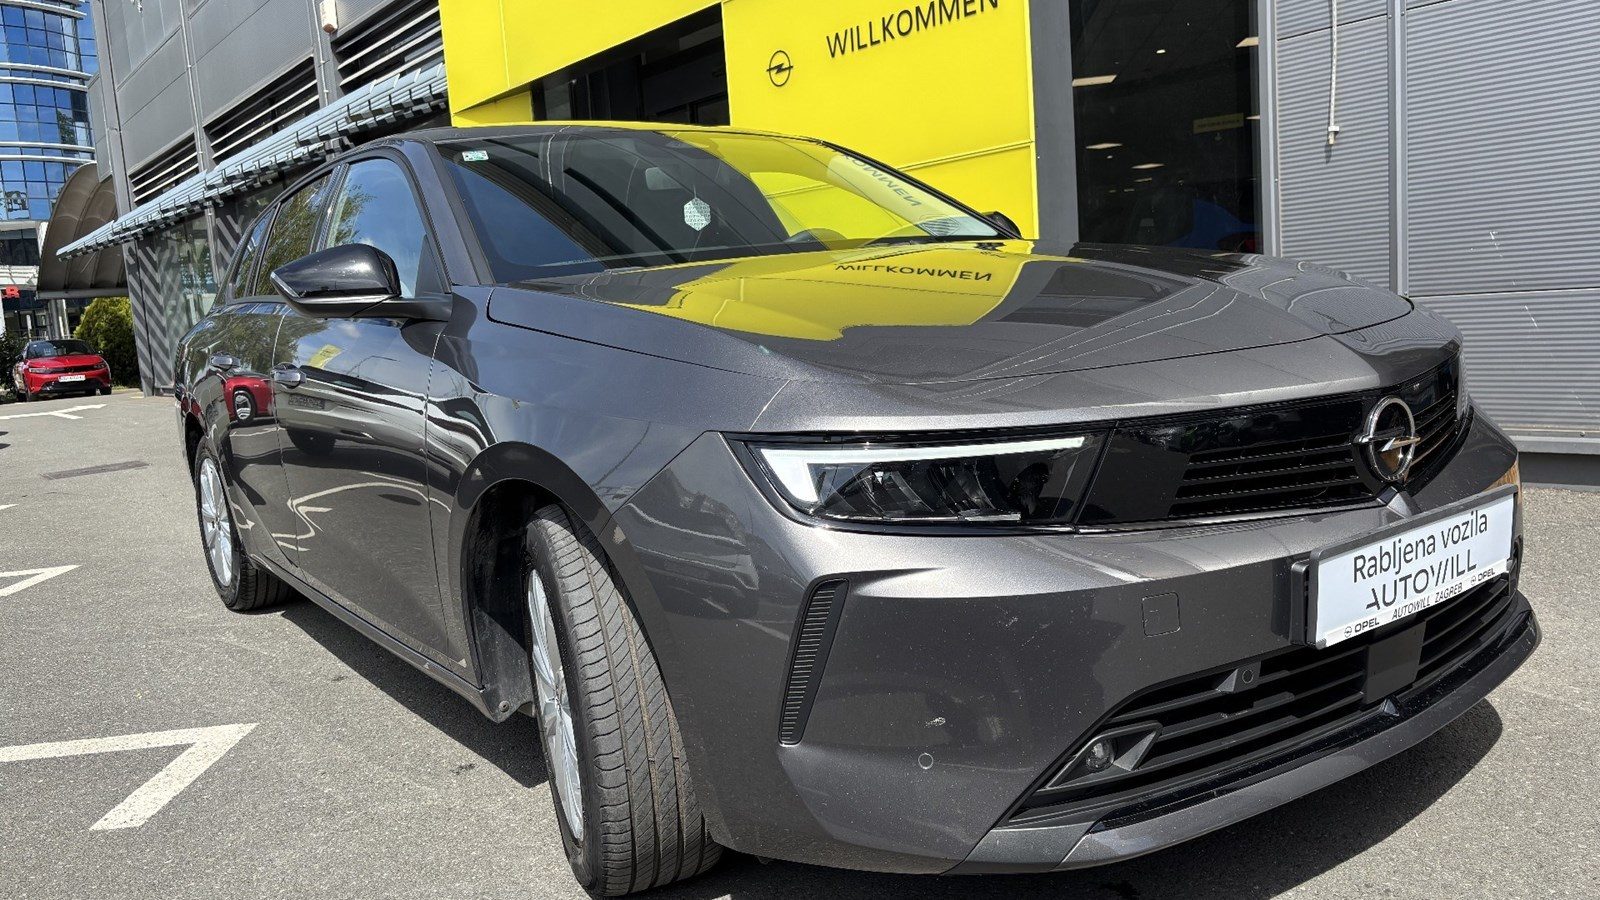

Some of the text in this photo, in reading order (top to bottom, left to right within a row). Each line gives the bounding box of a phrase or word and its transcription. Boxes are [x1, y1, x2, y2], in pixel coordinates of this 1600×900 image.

[1353, 510, 1488, 583] Rabljena vozila
[1366, 549, 1477, 610] AUTOWILL
[1354, 567, 1496, 633] OPEL AUTOWILL ZAGREB OPEL
